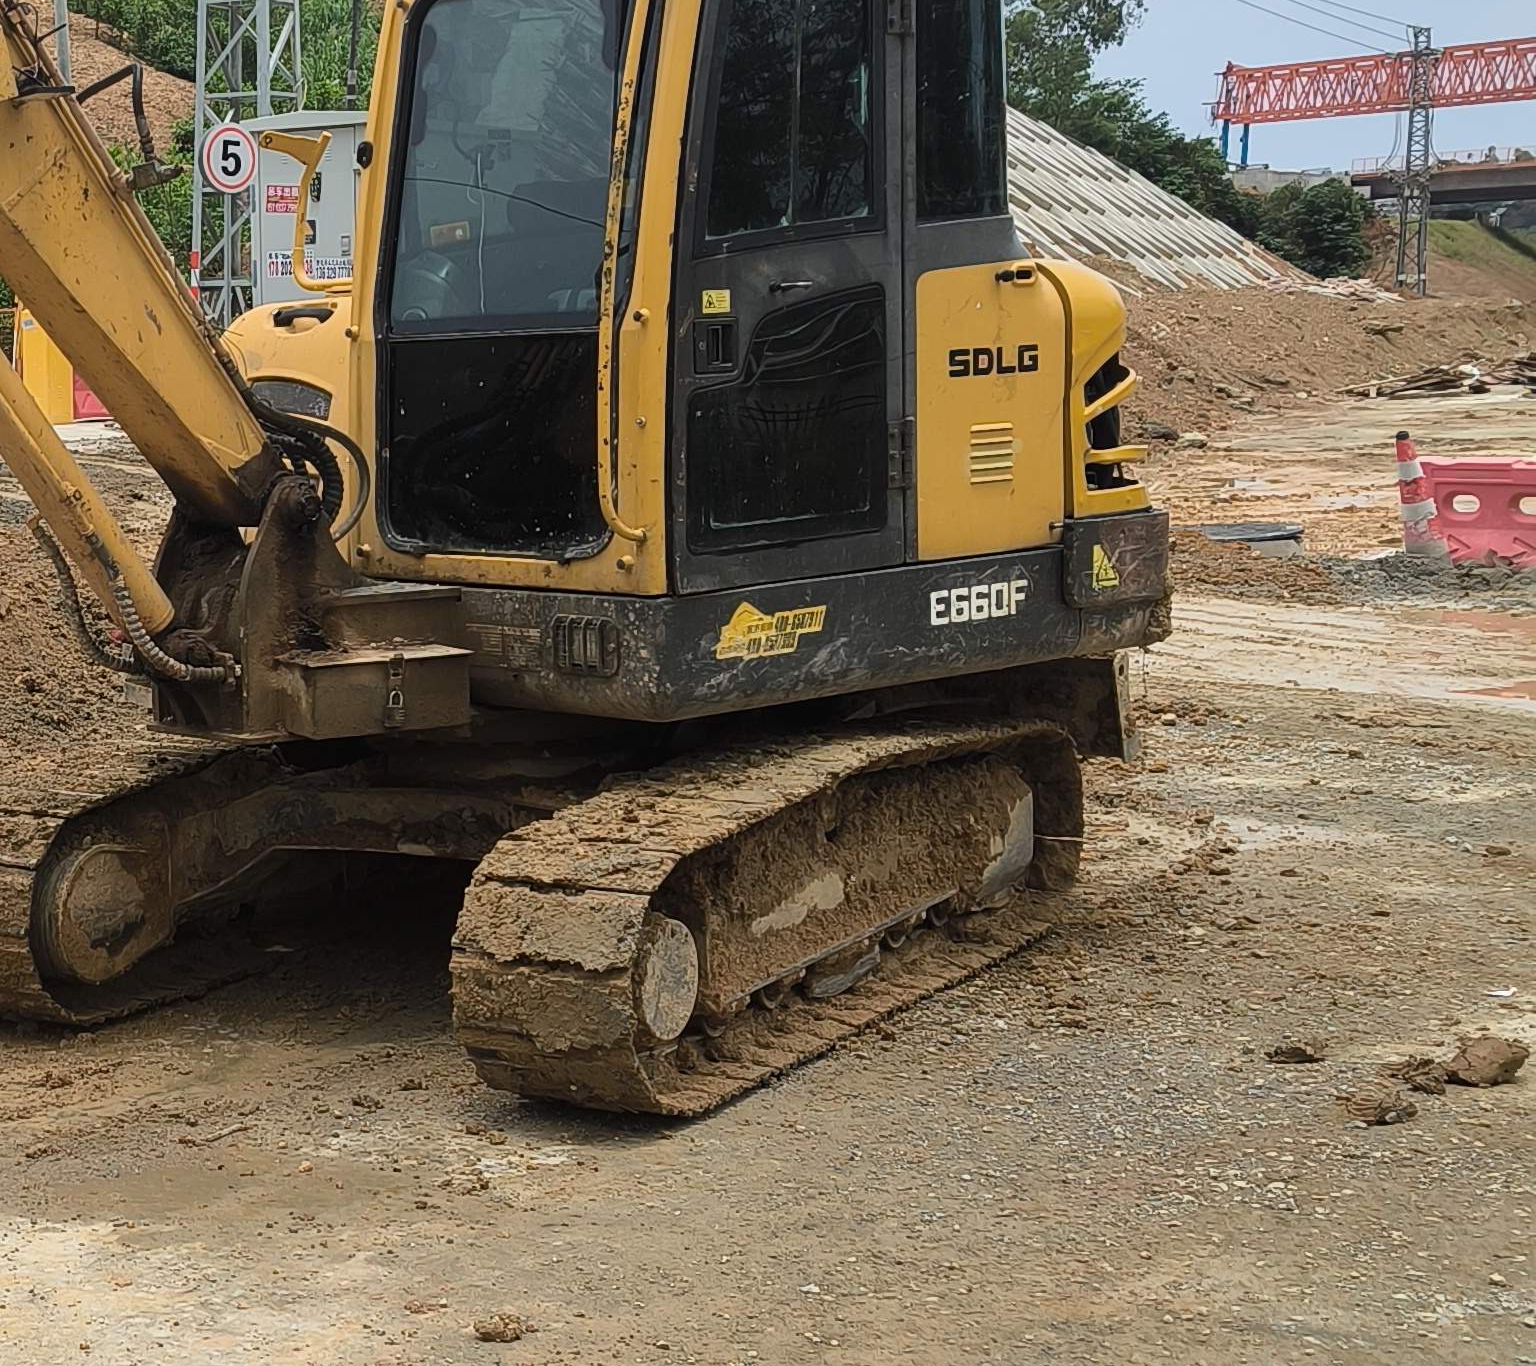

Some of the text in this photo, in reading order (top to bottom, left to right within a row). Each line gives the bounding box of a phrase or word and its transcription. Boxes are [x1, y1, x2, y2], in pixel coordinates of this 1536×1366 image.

[221, 139, 242, 176] 5
[948, 344, 1039, 378] SDLG
[930, 579, 1028, 626] E660F
